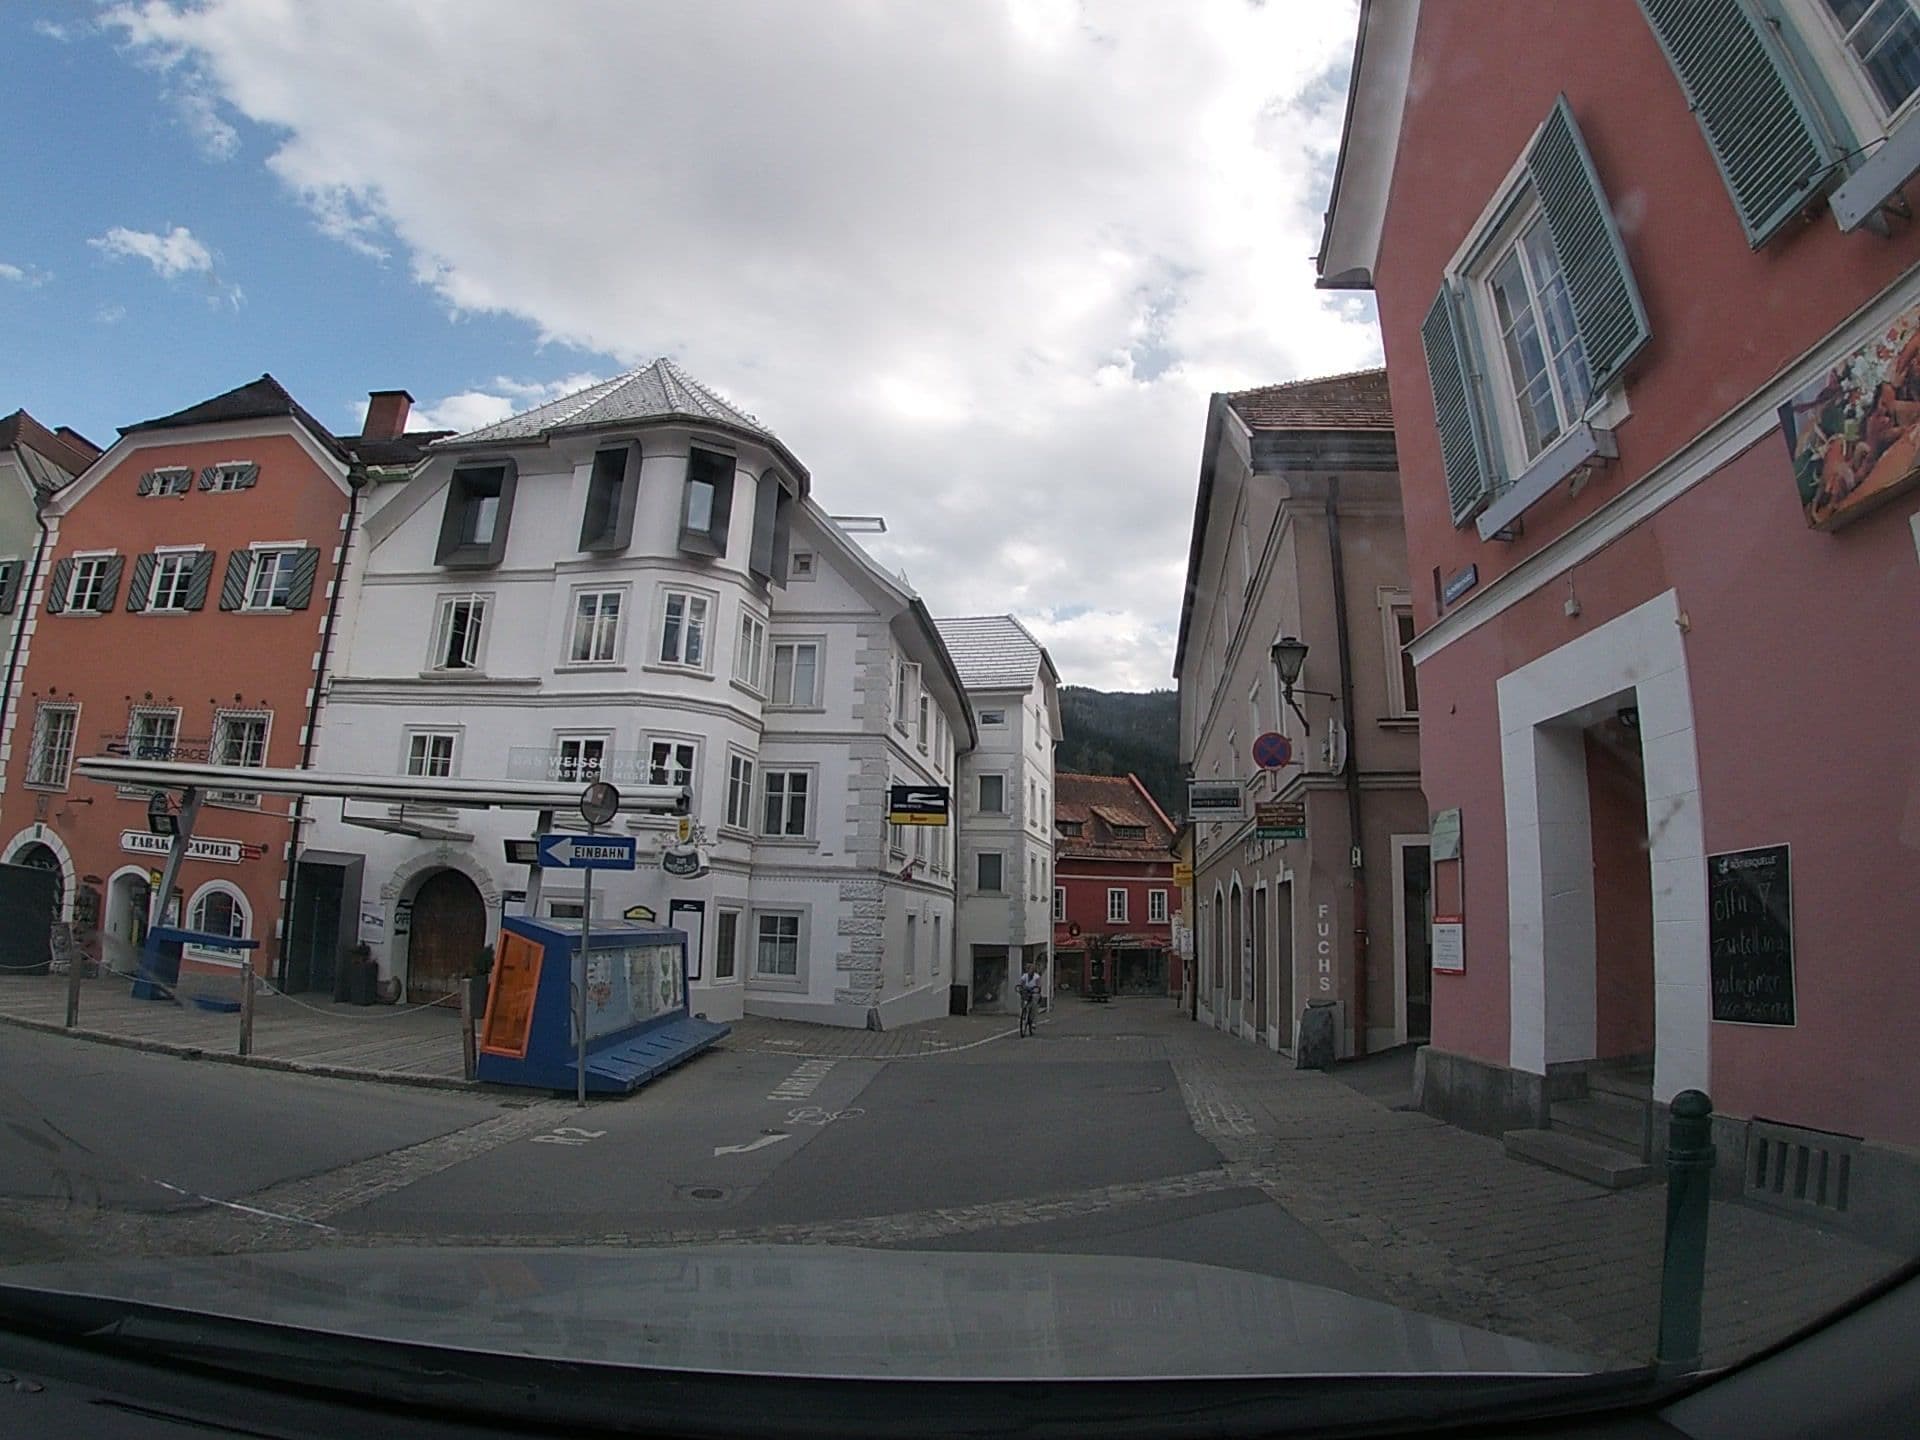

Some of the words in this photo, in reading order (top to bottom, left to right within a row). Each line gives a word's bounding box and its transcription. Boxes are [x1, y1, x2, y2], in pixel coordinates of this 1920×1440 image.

[549, 756, 608, 769] WEISSE
[130, 835, 169, 850] TABAK
[574, 846, 625, 859] EINBAHN
[1317, 903, 1331, 992] FUCHS
